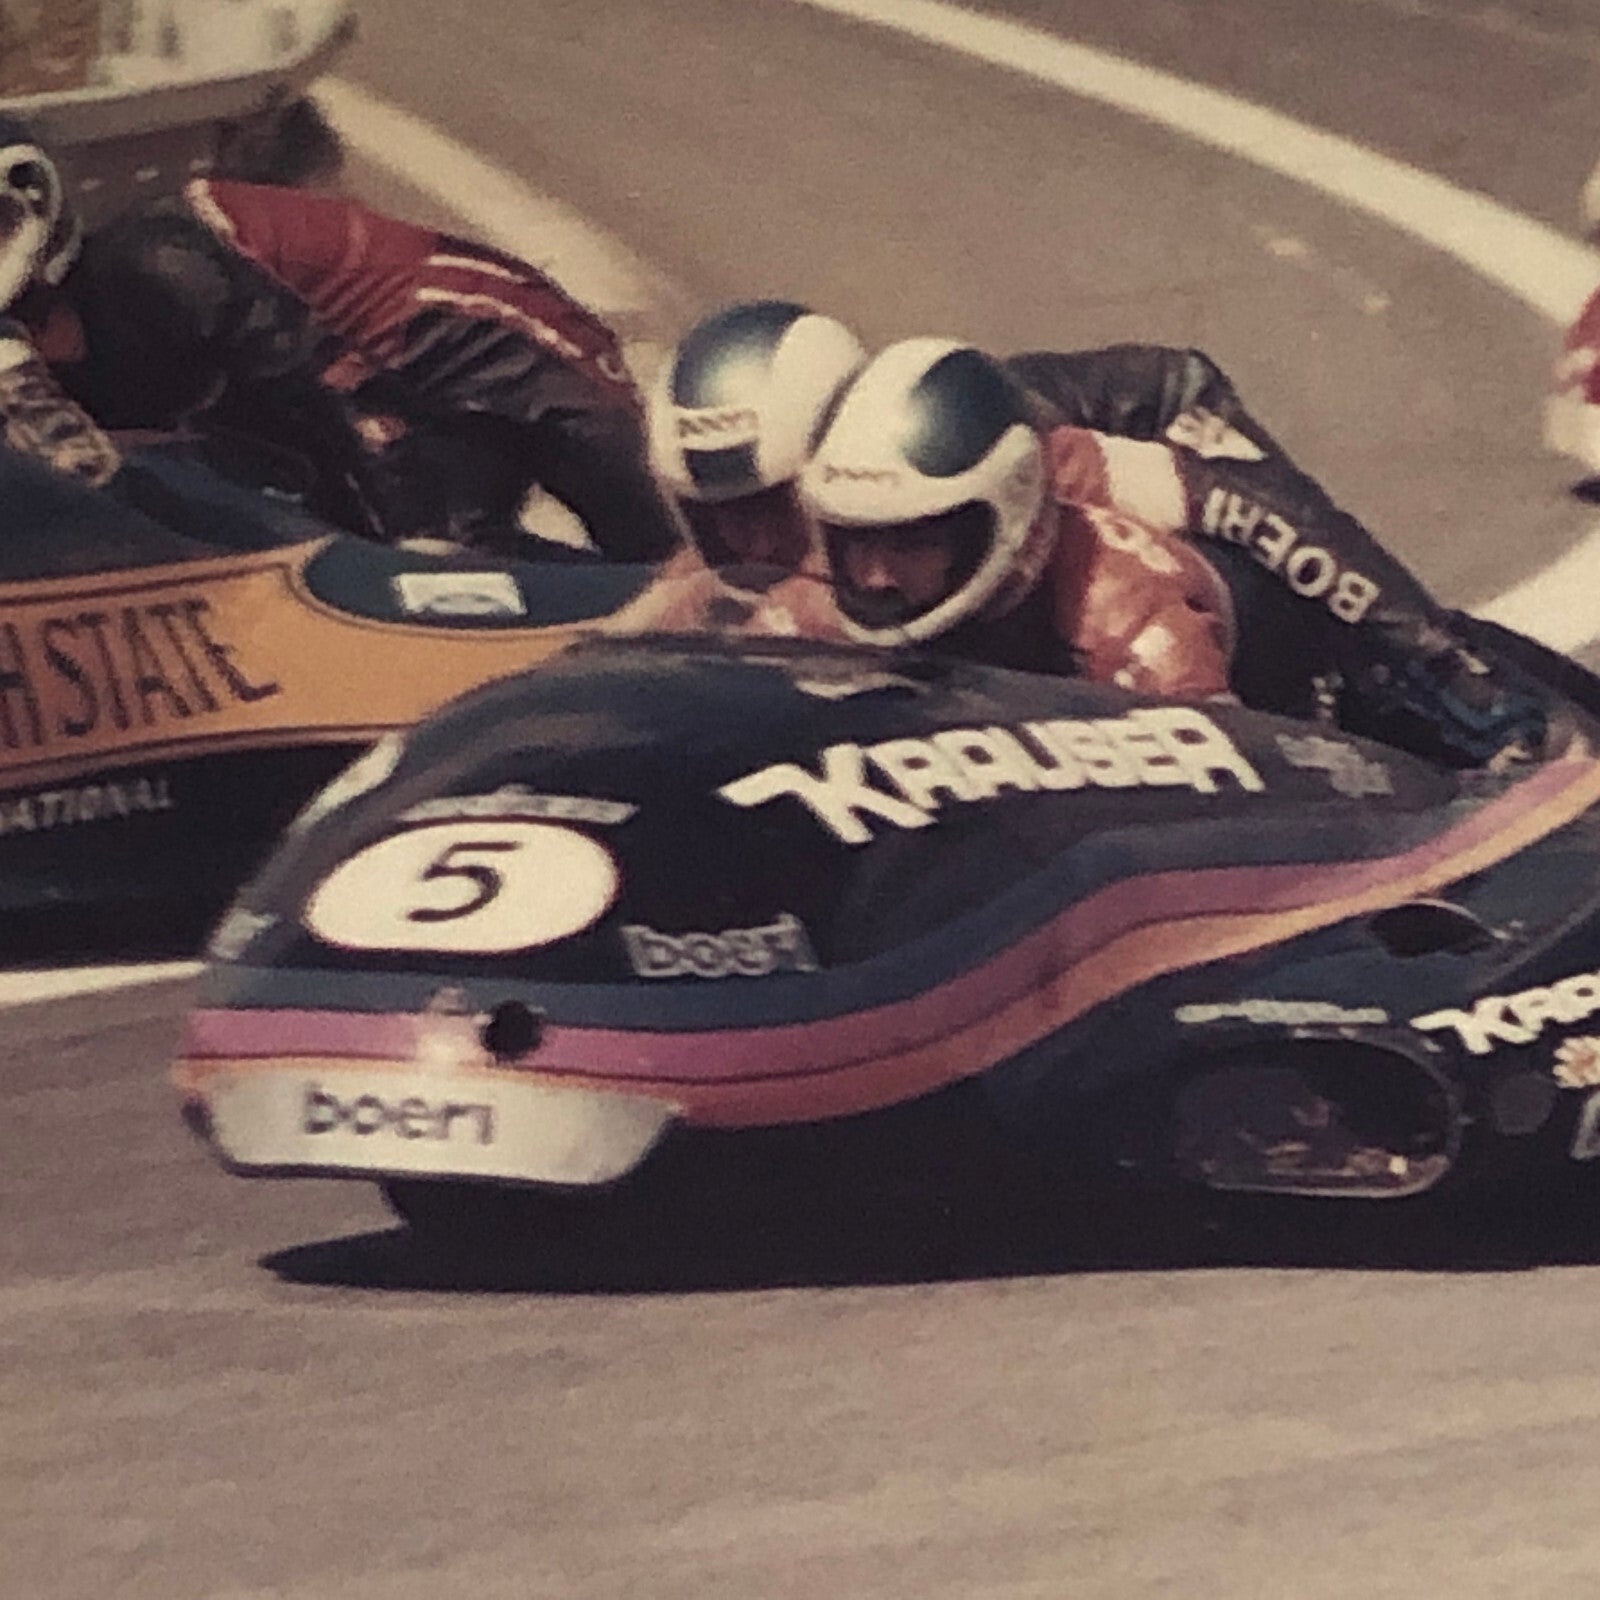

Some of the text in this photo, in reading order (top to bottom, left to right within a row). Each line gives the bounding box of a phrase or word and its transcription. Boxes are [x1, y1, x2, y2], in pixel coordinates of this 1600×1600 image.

[1202, 487, 1381, 624] BOERI
[43, 598, 281, 736] STATE
[0, 778, 173, 835] ATIONAL
[717, 706, 1266, 843] KRAUSER
[407, 841, 523, 922] 5
